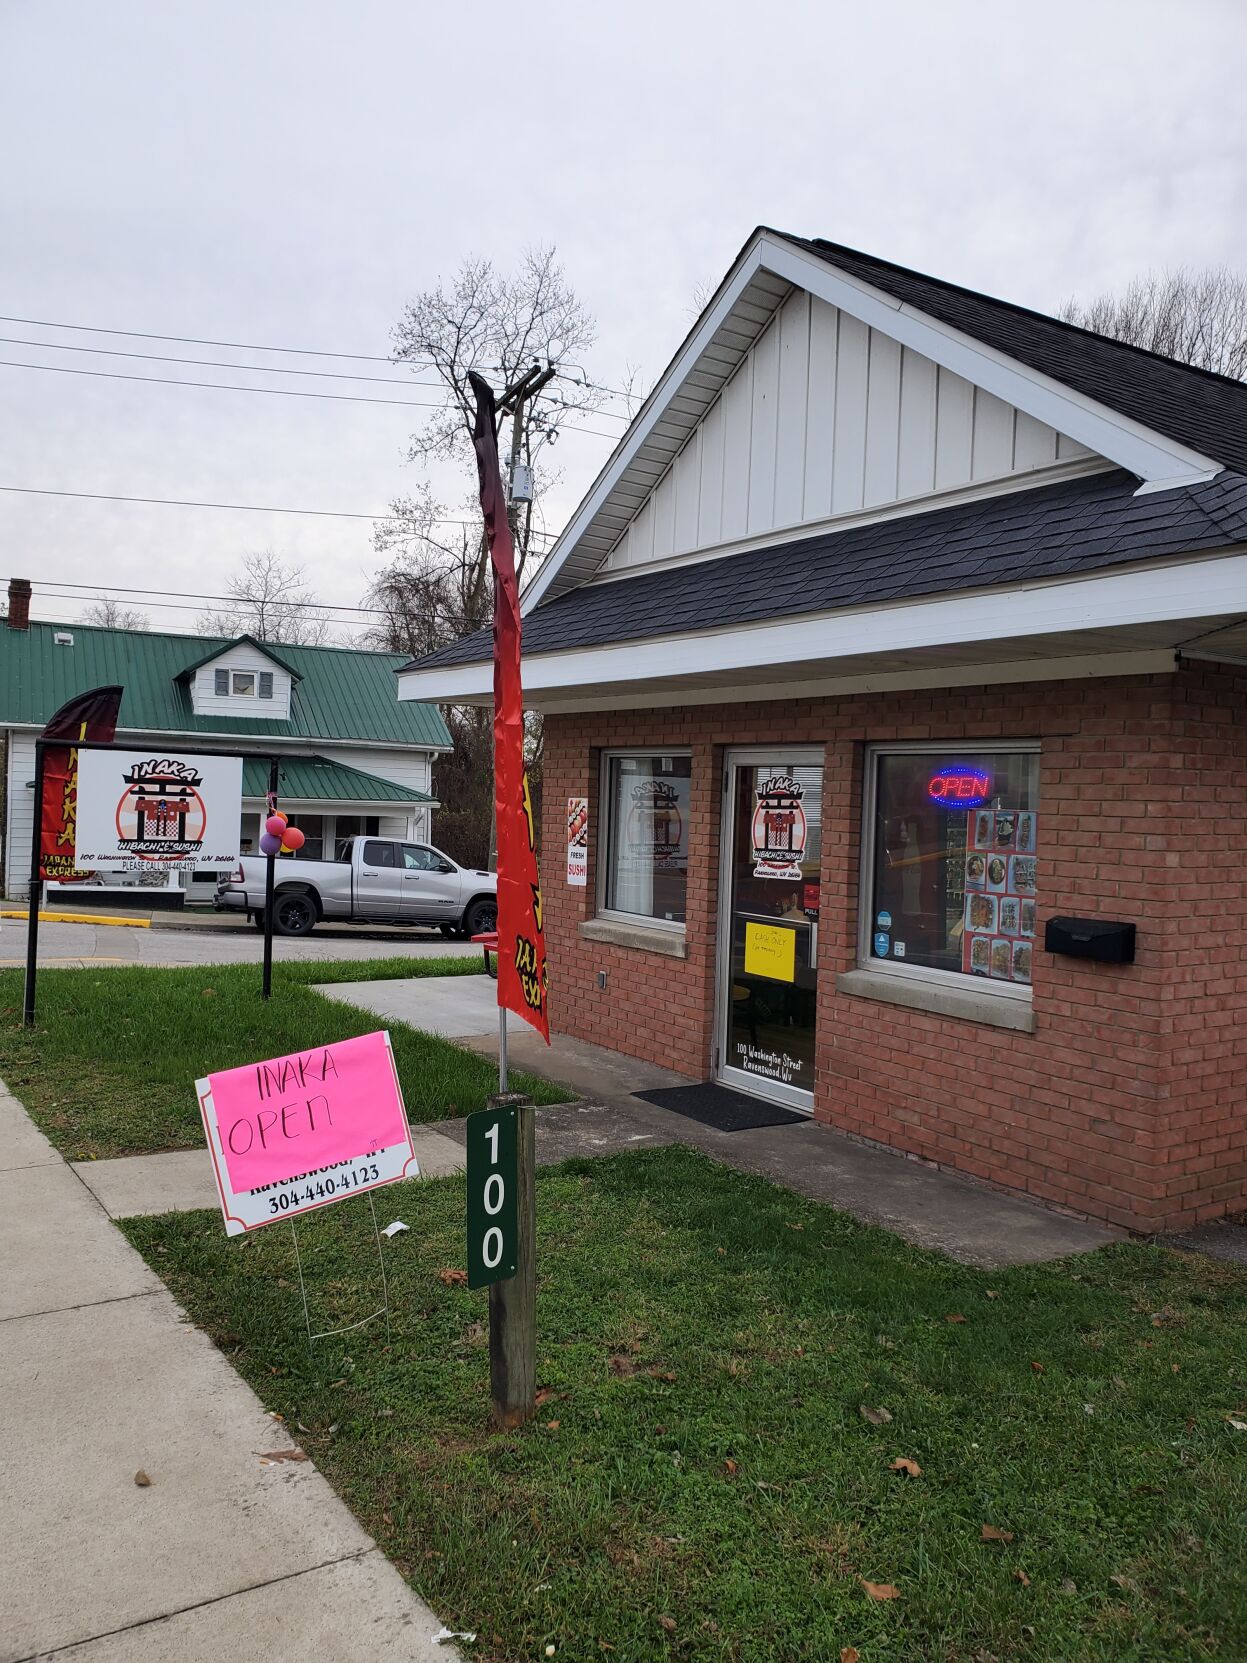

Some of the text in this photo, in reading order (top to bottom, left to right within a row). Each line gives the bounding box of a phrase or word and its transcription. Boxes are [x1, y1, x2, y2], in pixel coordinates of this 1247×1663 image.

[131, 759, 199, 781] INAKA
[761, 776, 800, 796] INAKA
[929, 776, 990, 797] OPEN
[118, 841, 160, 851] HIBACHI
[173, 842, 201, 852] SUSHI
[42, 855, 76, 866] JAPAN
[80, 853, 95, 861] 100
[570, 852, 585, 860] FRESH
[785, 852, 803, 861] SUSHI
[122, 861, 196, 871] PLEASE CALL 304-440-4123
[568, 864, 586, 876] SUSHI
[805, 908, 818, 916] PULL
[737, 1043, 804, 1071] 100 Washington Street
[256, 1049, 339, 1101] INAKA
[268, 1163, 380, 1214] 304-440-4123
[482, 1122, 505, 1268] 100
